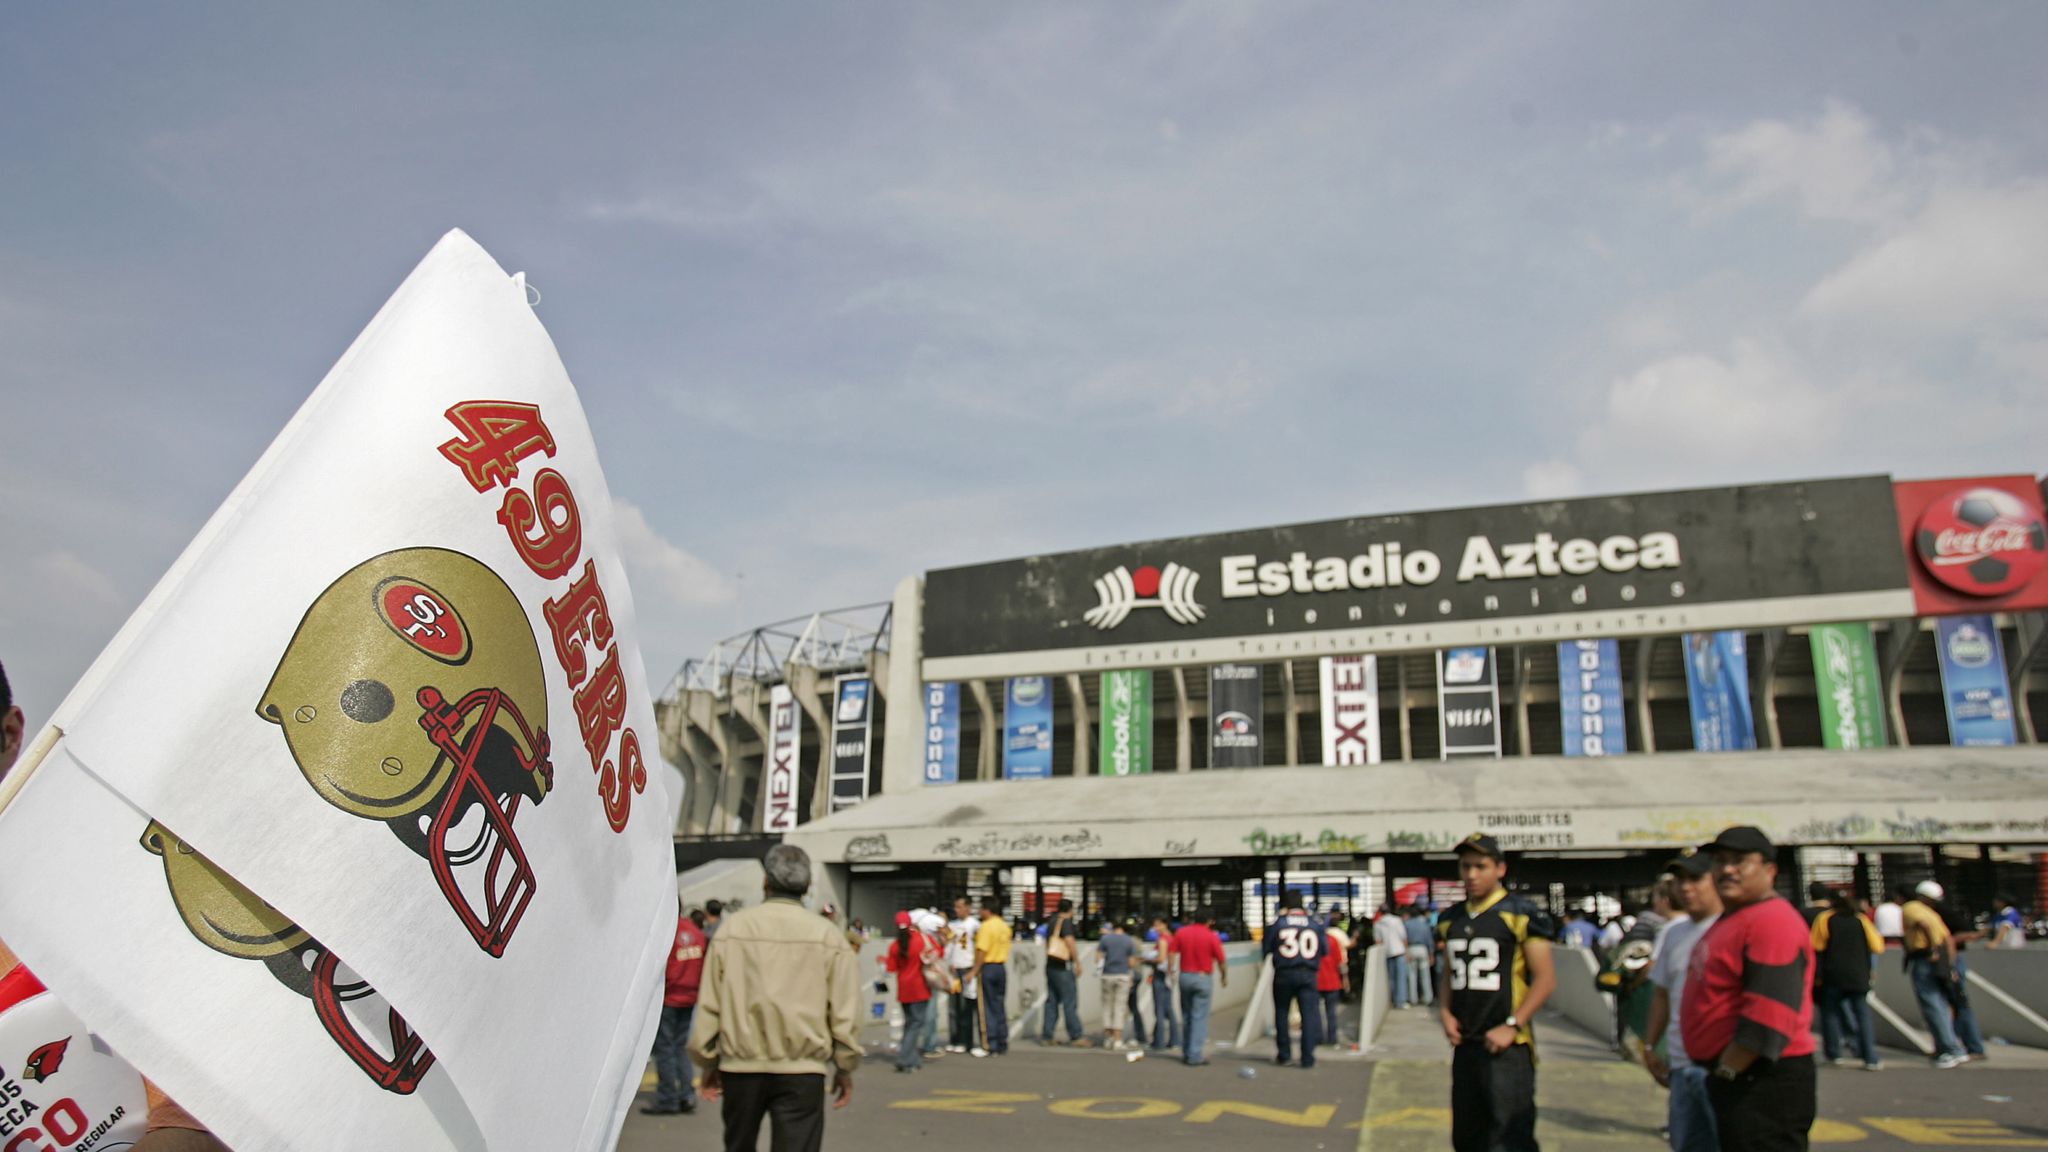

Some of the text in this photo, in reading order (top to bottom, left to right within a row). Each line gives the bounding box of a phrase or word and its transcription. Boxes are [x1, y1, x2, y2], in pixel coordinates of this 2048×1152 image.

[1220, 531, 1681, 599] Estadio Azteca
[402, 593, 448, 639] SF
[437, 400, 647, 834] 49ERS
[1478, 813, 1572, 827] TORNIQUETES
[1495, 833, 1574, 848] SURGENTES
[1278, 928, 1319, 959] 30
[1446, 937, 1501, 990] 52
[75, 1105, 126, 1152] REGULAR
